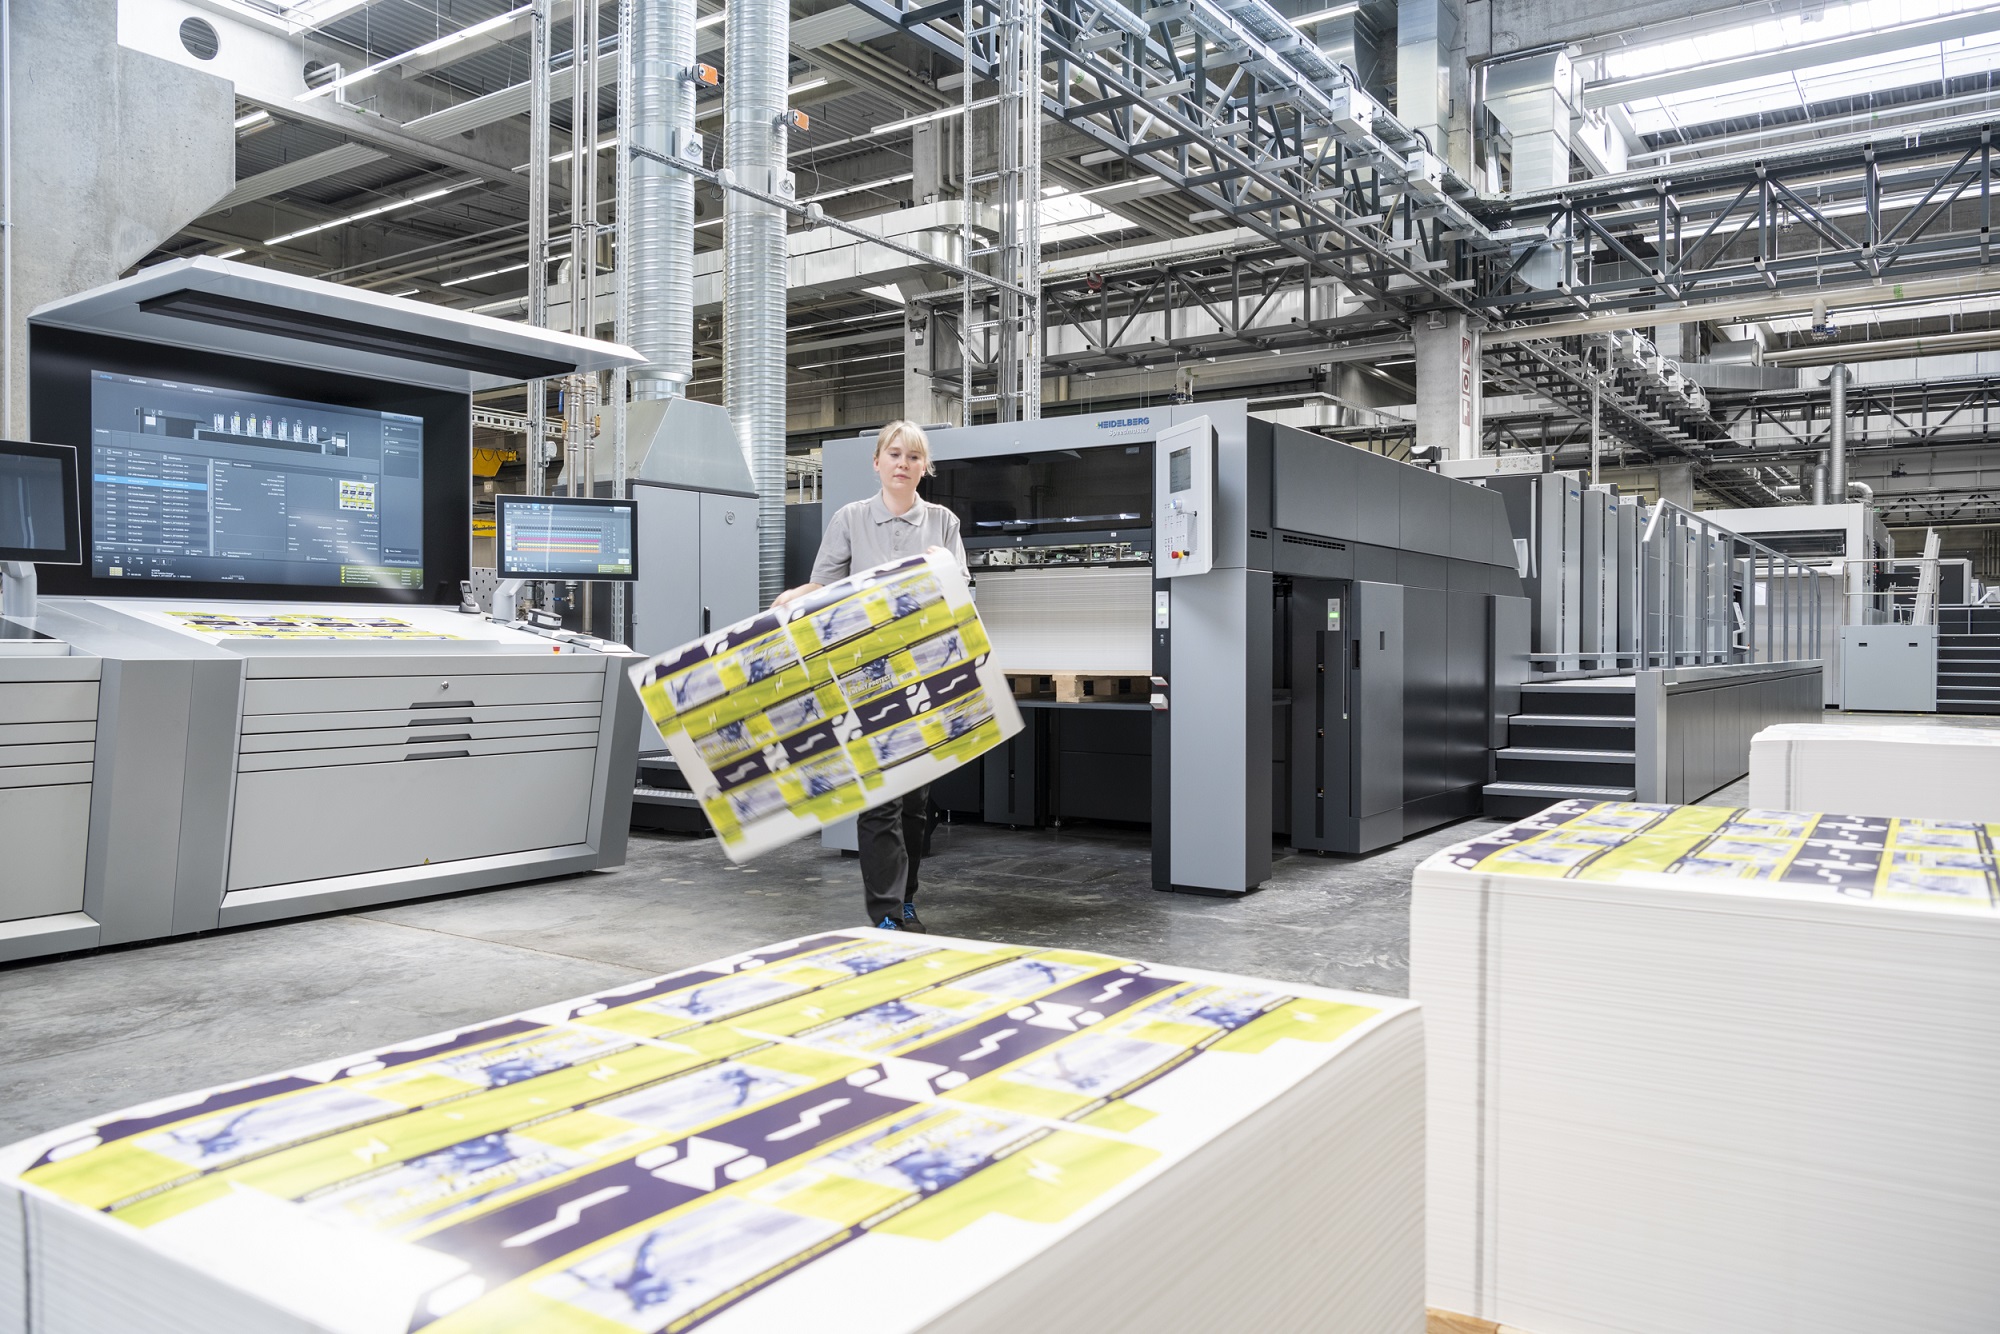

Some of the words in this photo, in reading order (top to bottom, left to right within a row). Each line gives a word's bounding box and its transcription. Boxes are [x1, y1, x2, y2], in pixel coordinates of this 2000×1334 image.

[1097, 417, 1150, 429] HEIDELBERG
[1108, 427, 1150, 437] Speedmaster
[867, 673, 892, 687] PROTECT
